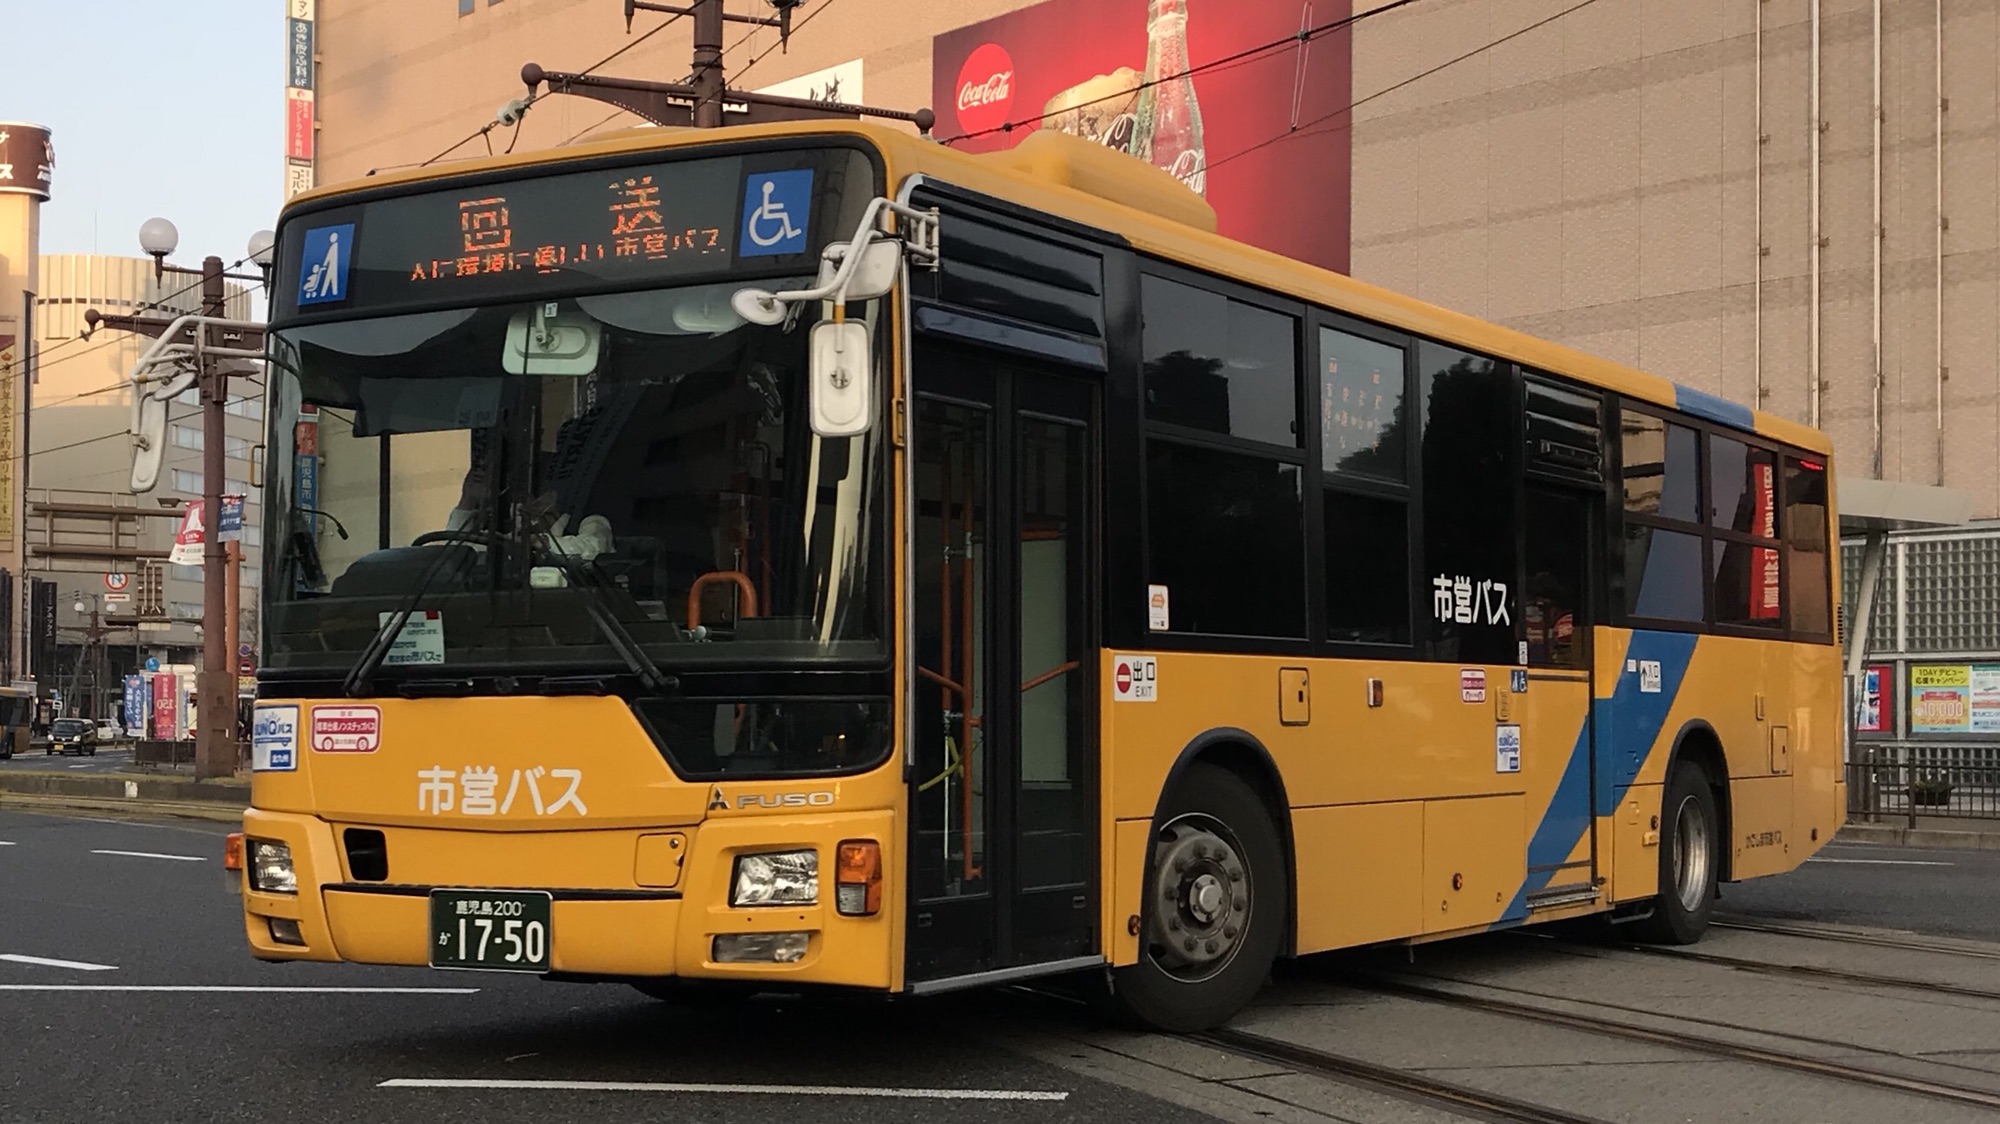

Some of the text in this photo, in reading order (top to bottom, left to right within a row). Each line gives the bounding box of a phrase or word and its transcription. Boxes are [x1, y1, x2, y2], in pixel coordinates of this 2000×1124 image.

[1433, 573, 1510, 626] 市営バス
[1133, 660, 1155, 681] 出口
[1135, 686, 1153, 697] EXIT
[417, 765, 588, 816] 市営バス
[737, 791, 835, 809] FUSO
[438, 918, 544, 963] か 17-50
